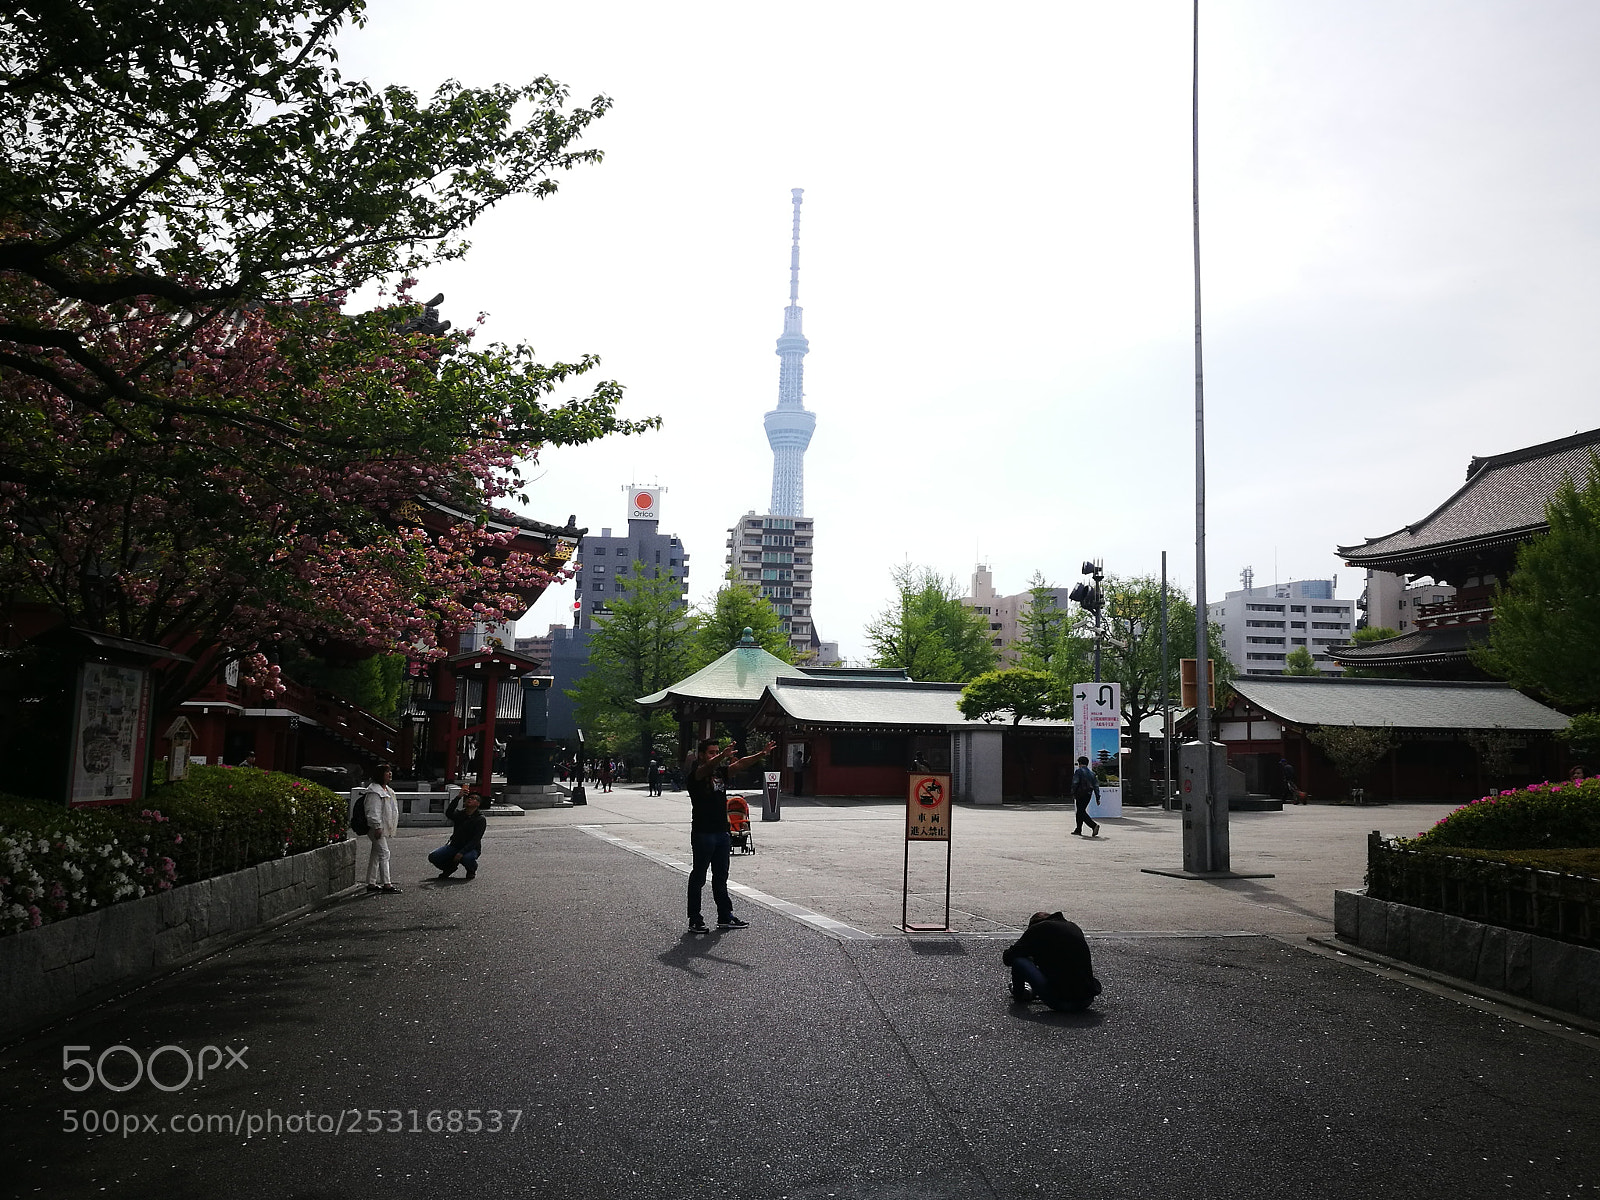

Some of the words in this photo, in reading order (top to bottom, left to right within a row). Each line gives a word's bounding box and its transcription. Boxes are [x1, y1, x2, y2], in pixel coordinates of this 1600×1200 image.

[633, 510, 654, 518] Orico
[910, 826, 946, 836] 進入禁止
